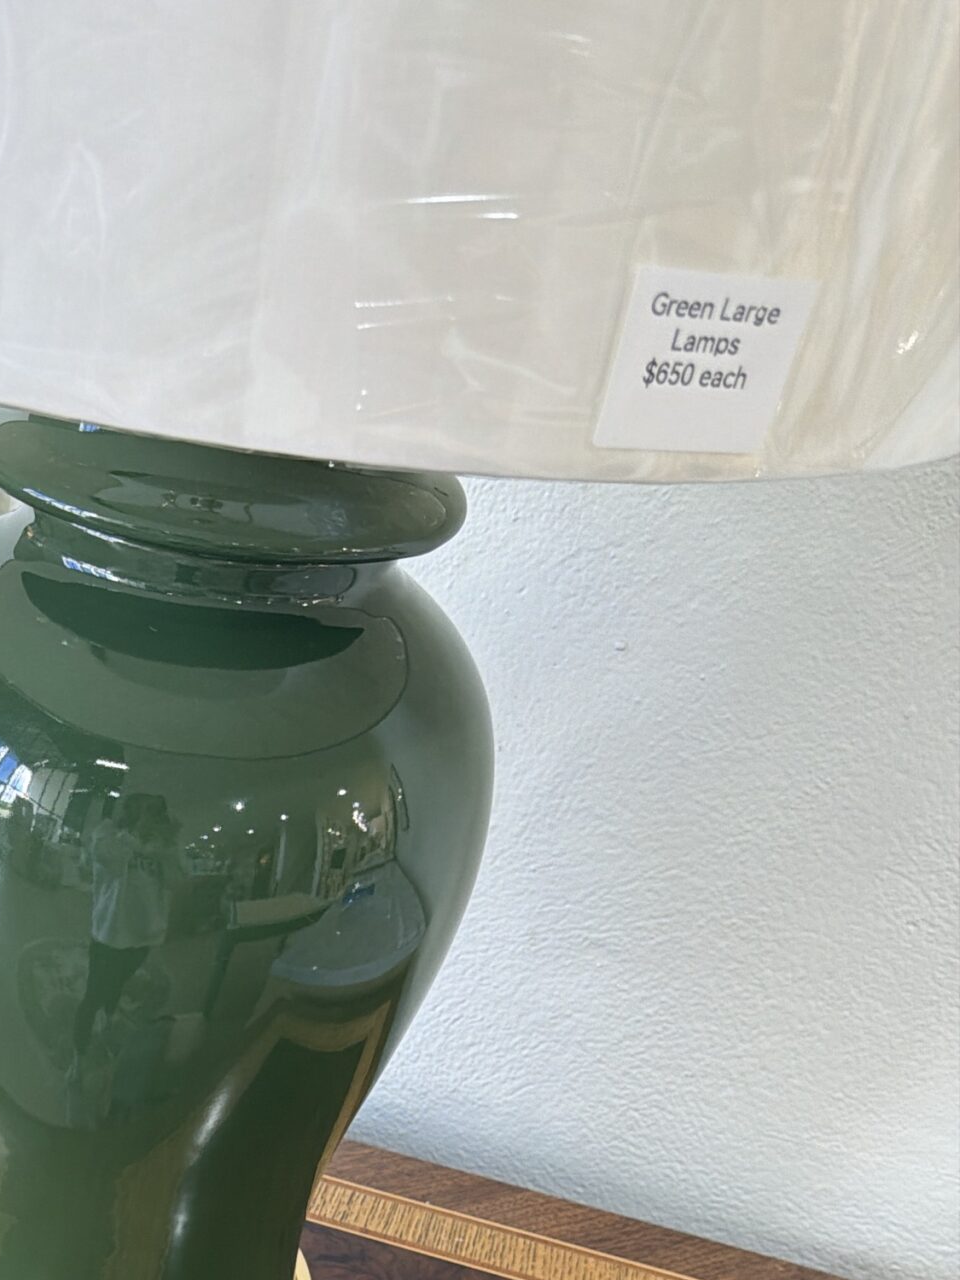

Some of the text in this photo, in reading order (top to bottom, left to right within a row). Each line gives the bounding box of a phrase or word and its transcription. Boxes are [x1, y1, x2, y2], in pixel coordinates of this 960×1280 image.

[650, 291, 781, 326] Green Large
[670, 327, 741, 357] Lamps
[642, 357, 747, 390] $650 each
